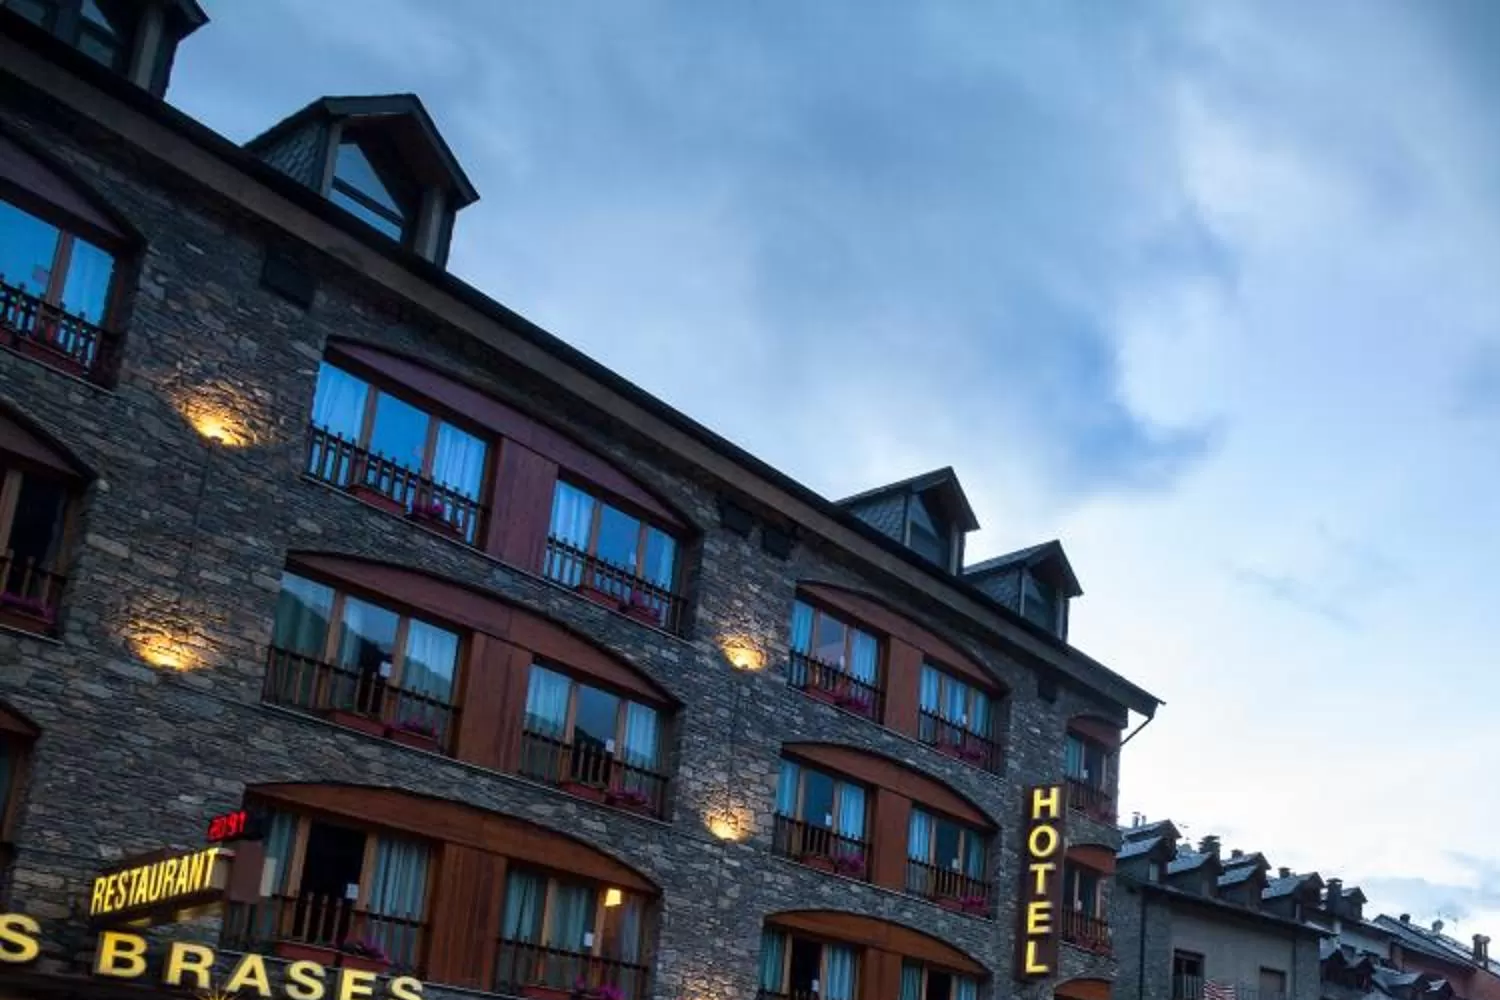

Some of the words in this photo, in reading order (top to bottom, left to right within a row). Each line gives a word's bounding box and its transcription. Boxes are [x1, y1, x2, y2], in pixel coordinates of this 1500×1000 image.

[90, 847, 219, 916] RESTAURANT
[1025, 786, 1061, 974] HOTEL
[0, 913, 40, 963] S
